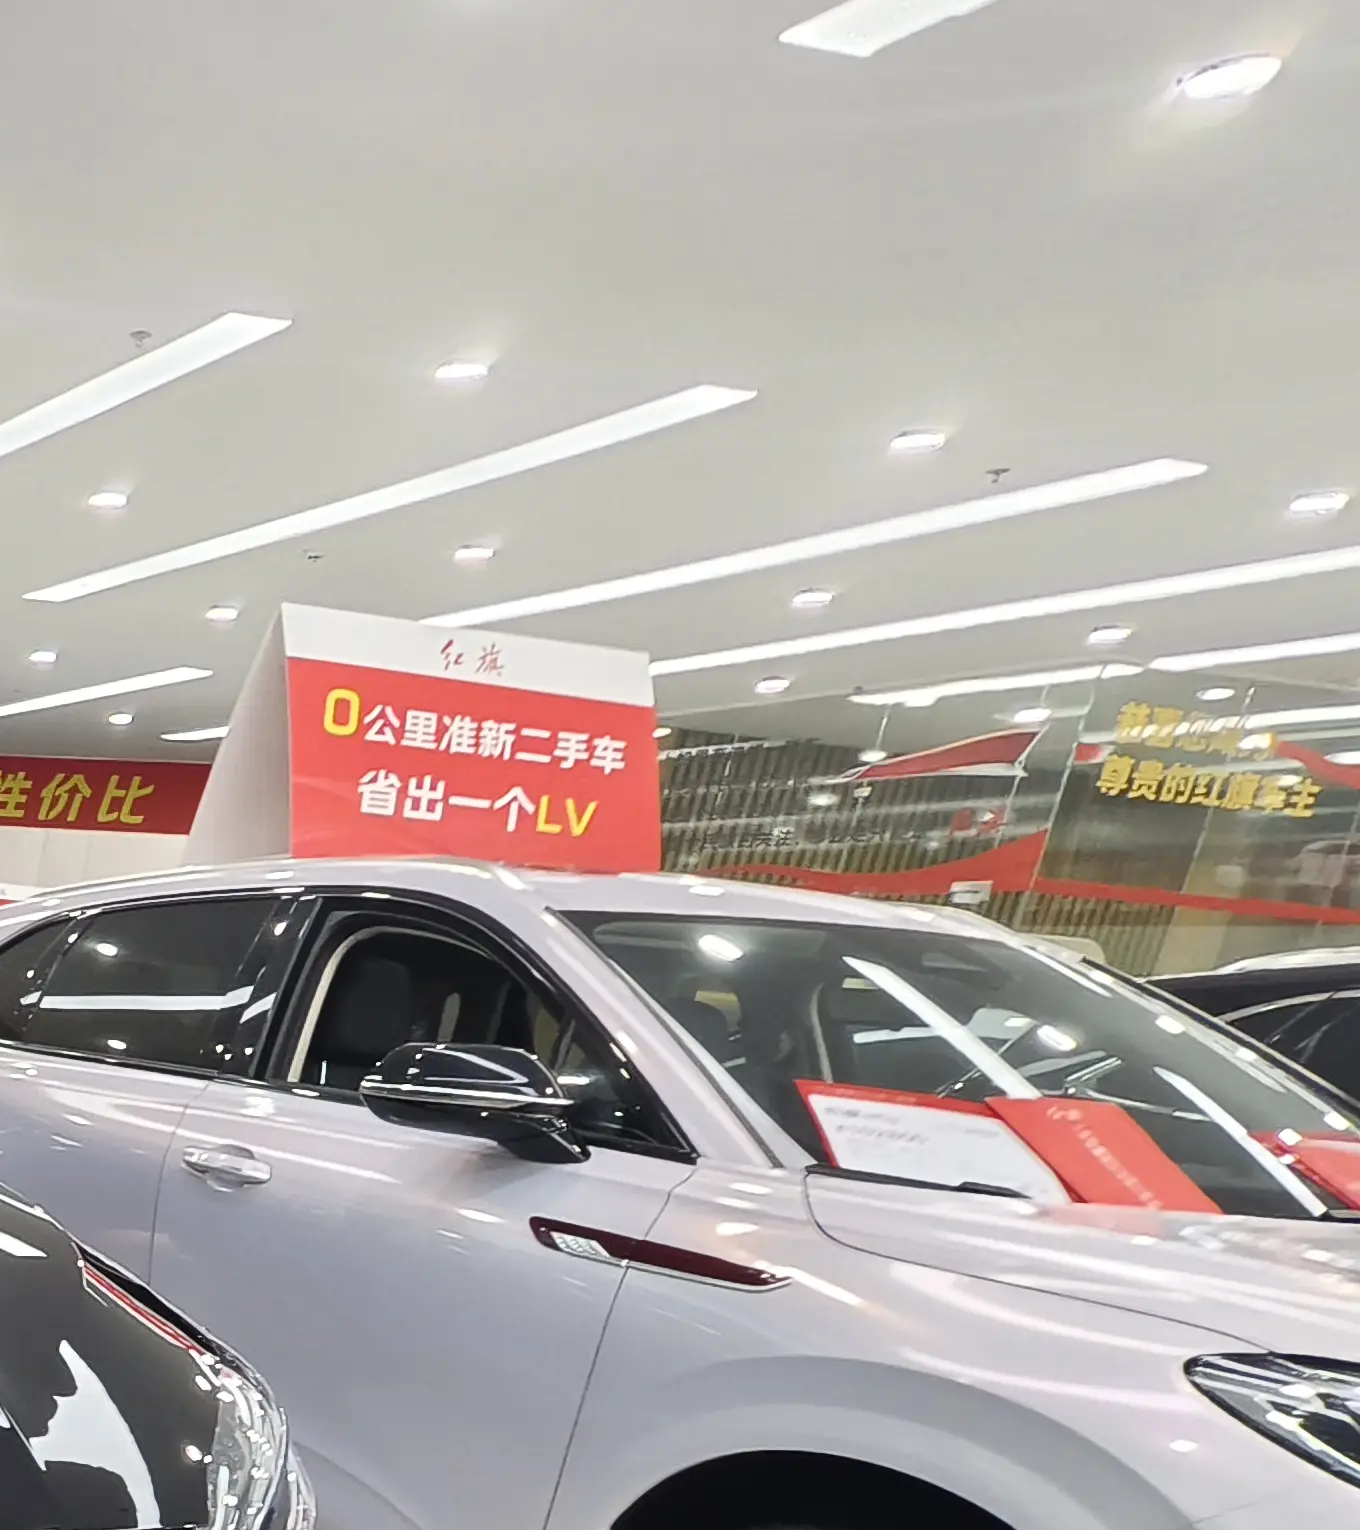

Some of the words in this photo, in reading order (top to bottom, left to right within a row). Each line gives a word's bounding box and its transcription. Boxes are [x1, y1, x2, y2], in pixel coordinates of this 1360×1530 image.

[440, 639, 506, 677] 红旗
[323, 688, 628, 776] 0公里准新二手车
[357, 768, 601, 837] 省出一个LV
